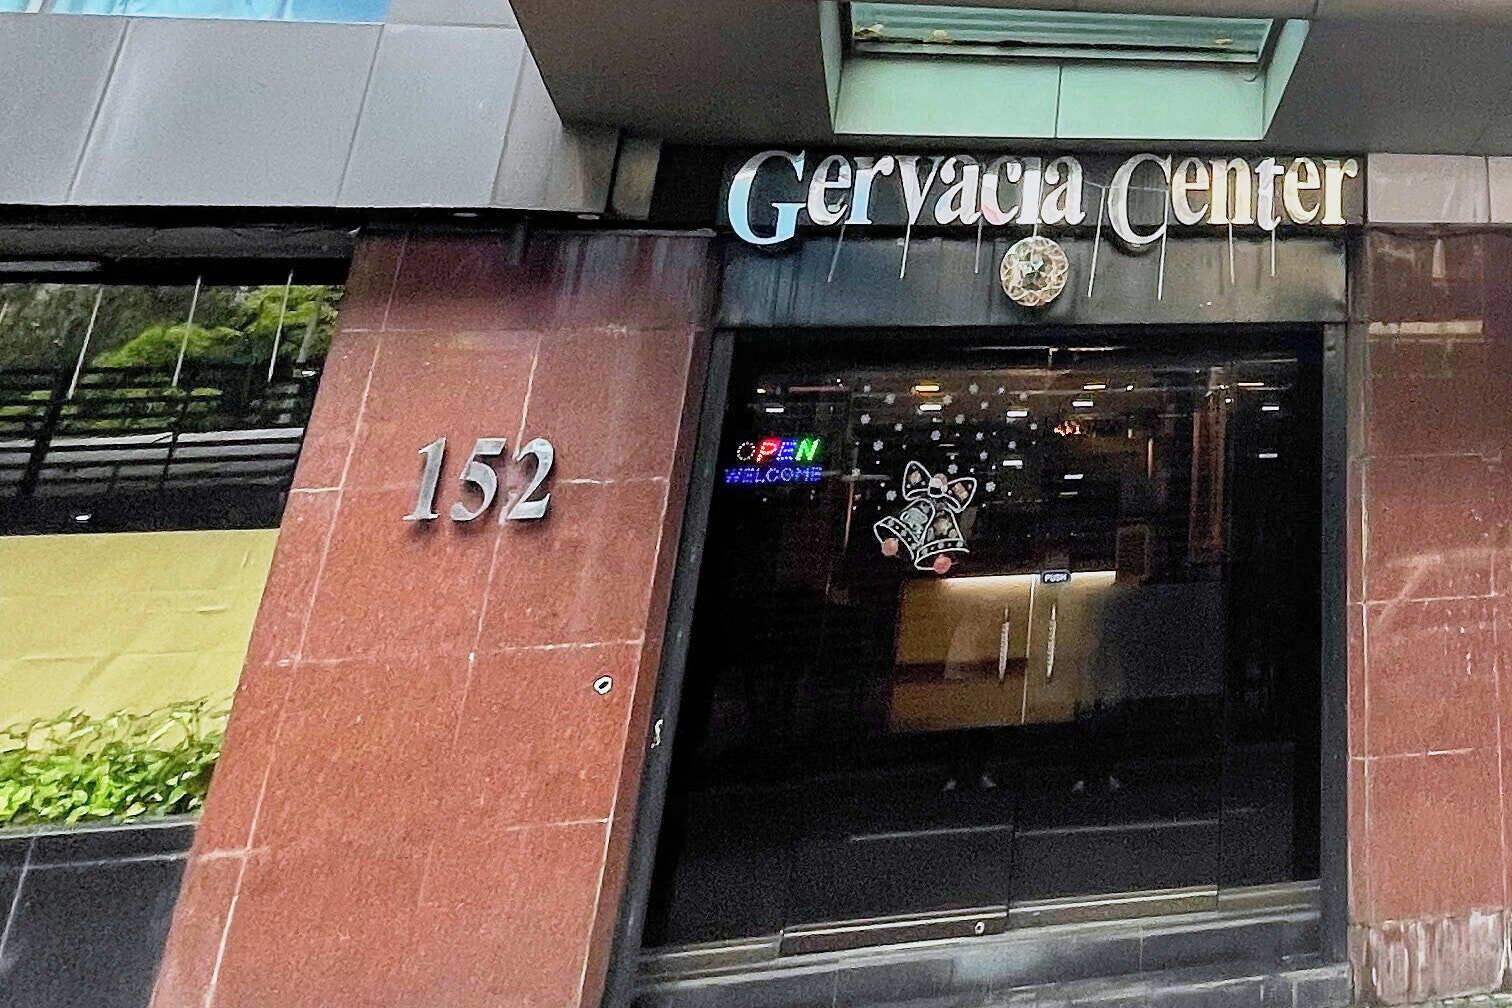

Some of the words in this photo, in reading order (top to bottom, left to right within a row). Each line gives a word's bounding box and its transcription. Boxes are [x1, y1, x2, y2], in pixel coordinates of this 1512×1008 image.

[727, 149, 1087, 245] Gervacia
[1107, 152, 1358, 245] Center
[736, 438, 821, 463] OPEN
[402, 436, 555, 522] 152
[724, 466, 823, 485] WELCOME
[1044, 573, 1068, 582] PUSH
